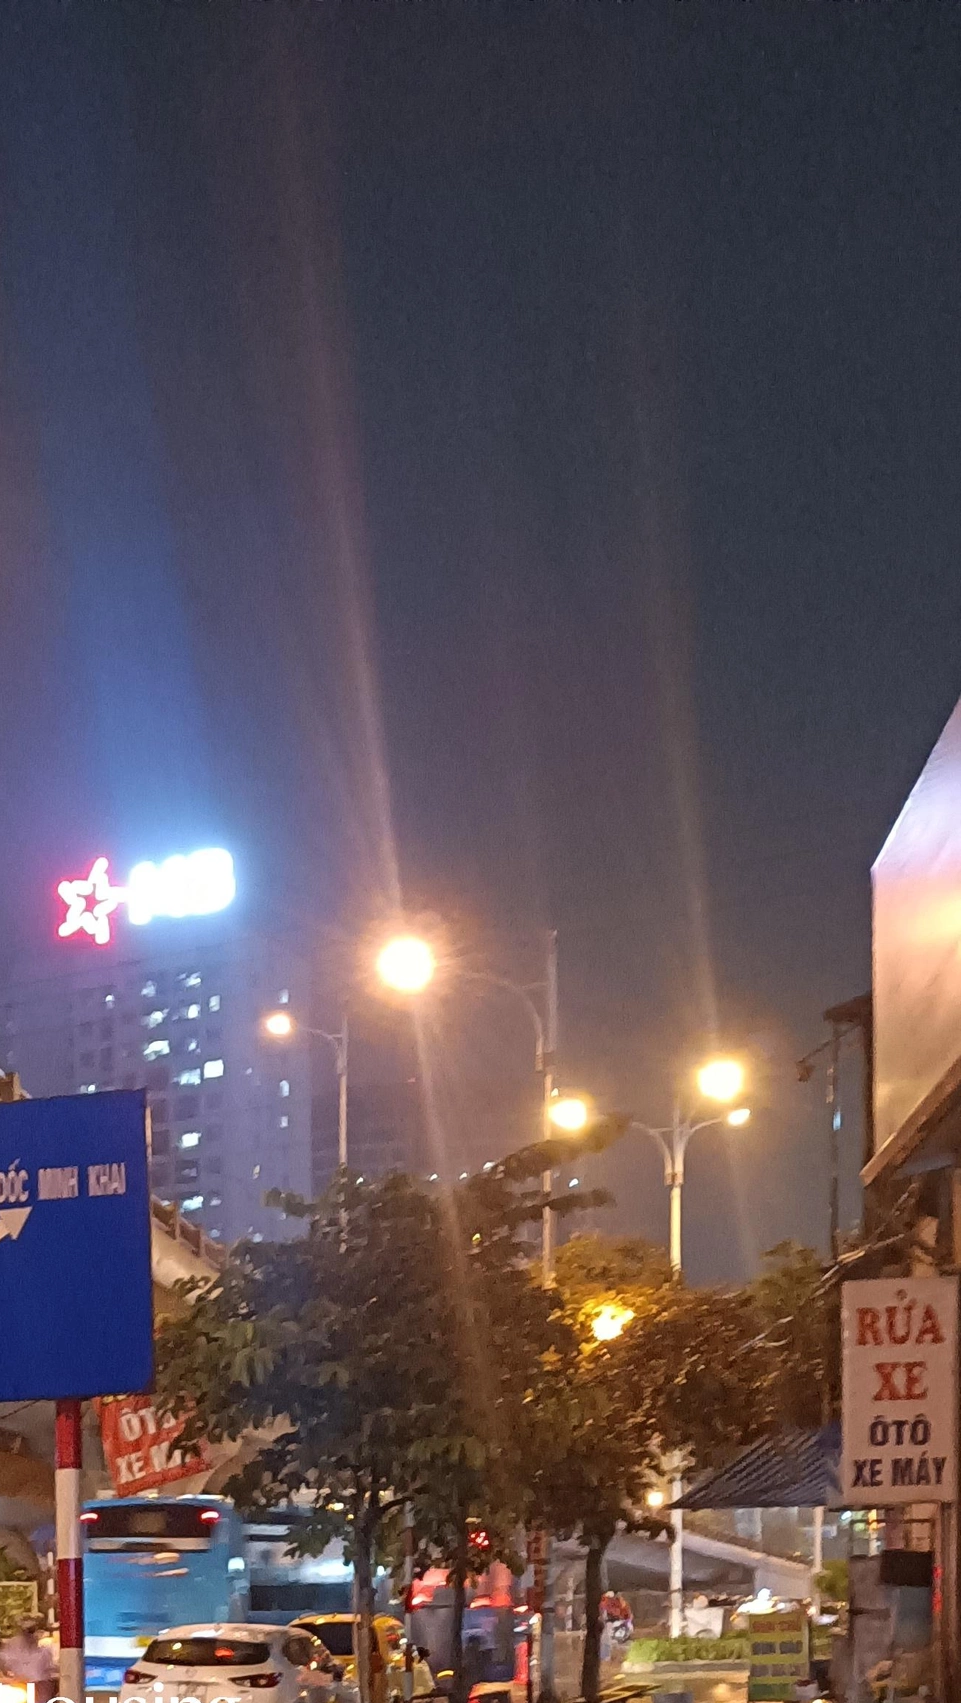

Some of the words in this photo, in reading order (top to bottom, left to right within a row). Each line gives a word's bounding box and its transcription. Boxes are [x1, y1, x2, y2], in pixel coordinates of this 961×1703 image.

[854, 1288, 946, 1346] RỬA
[872, 1360, 929, 1402] XE
[868, 1413, 932, 1447] ÔTÔ
[851, 1457, 884, 1488] XE
[891, 1450, 948, 1487] MÁY
